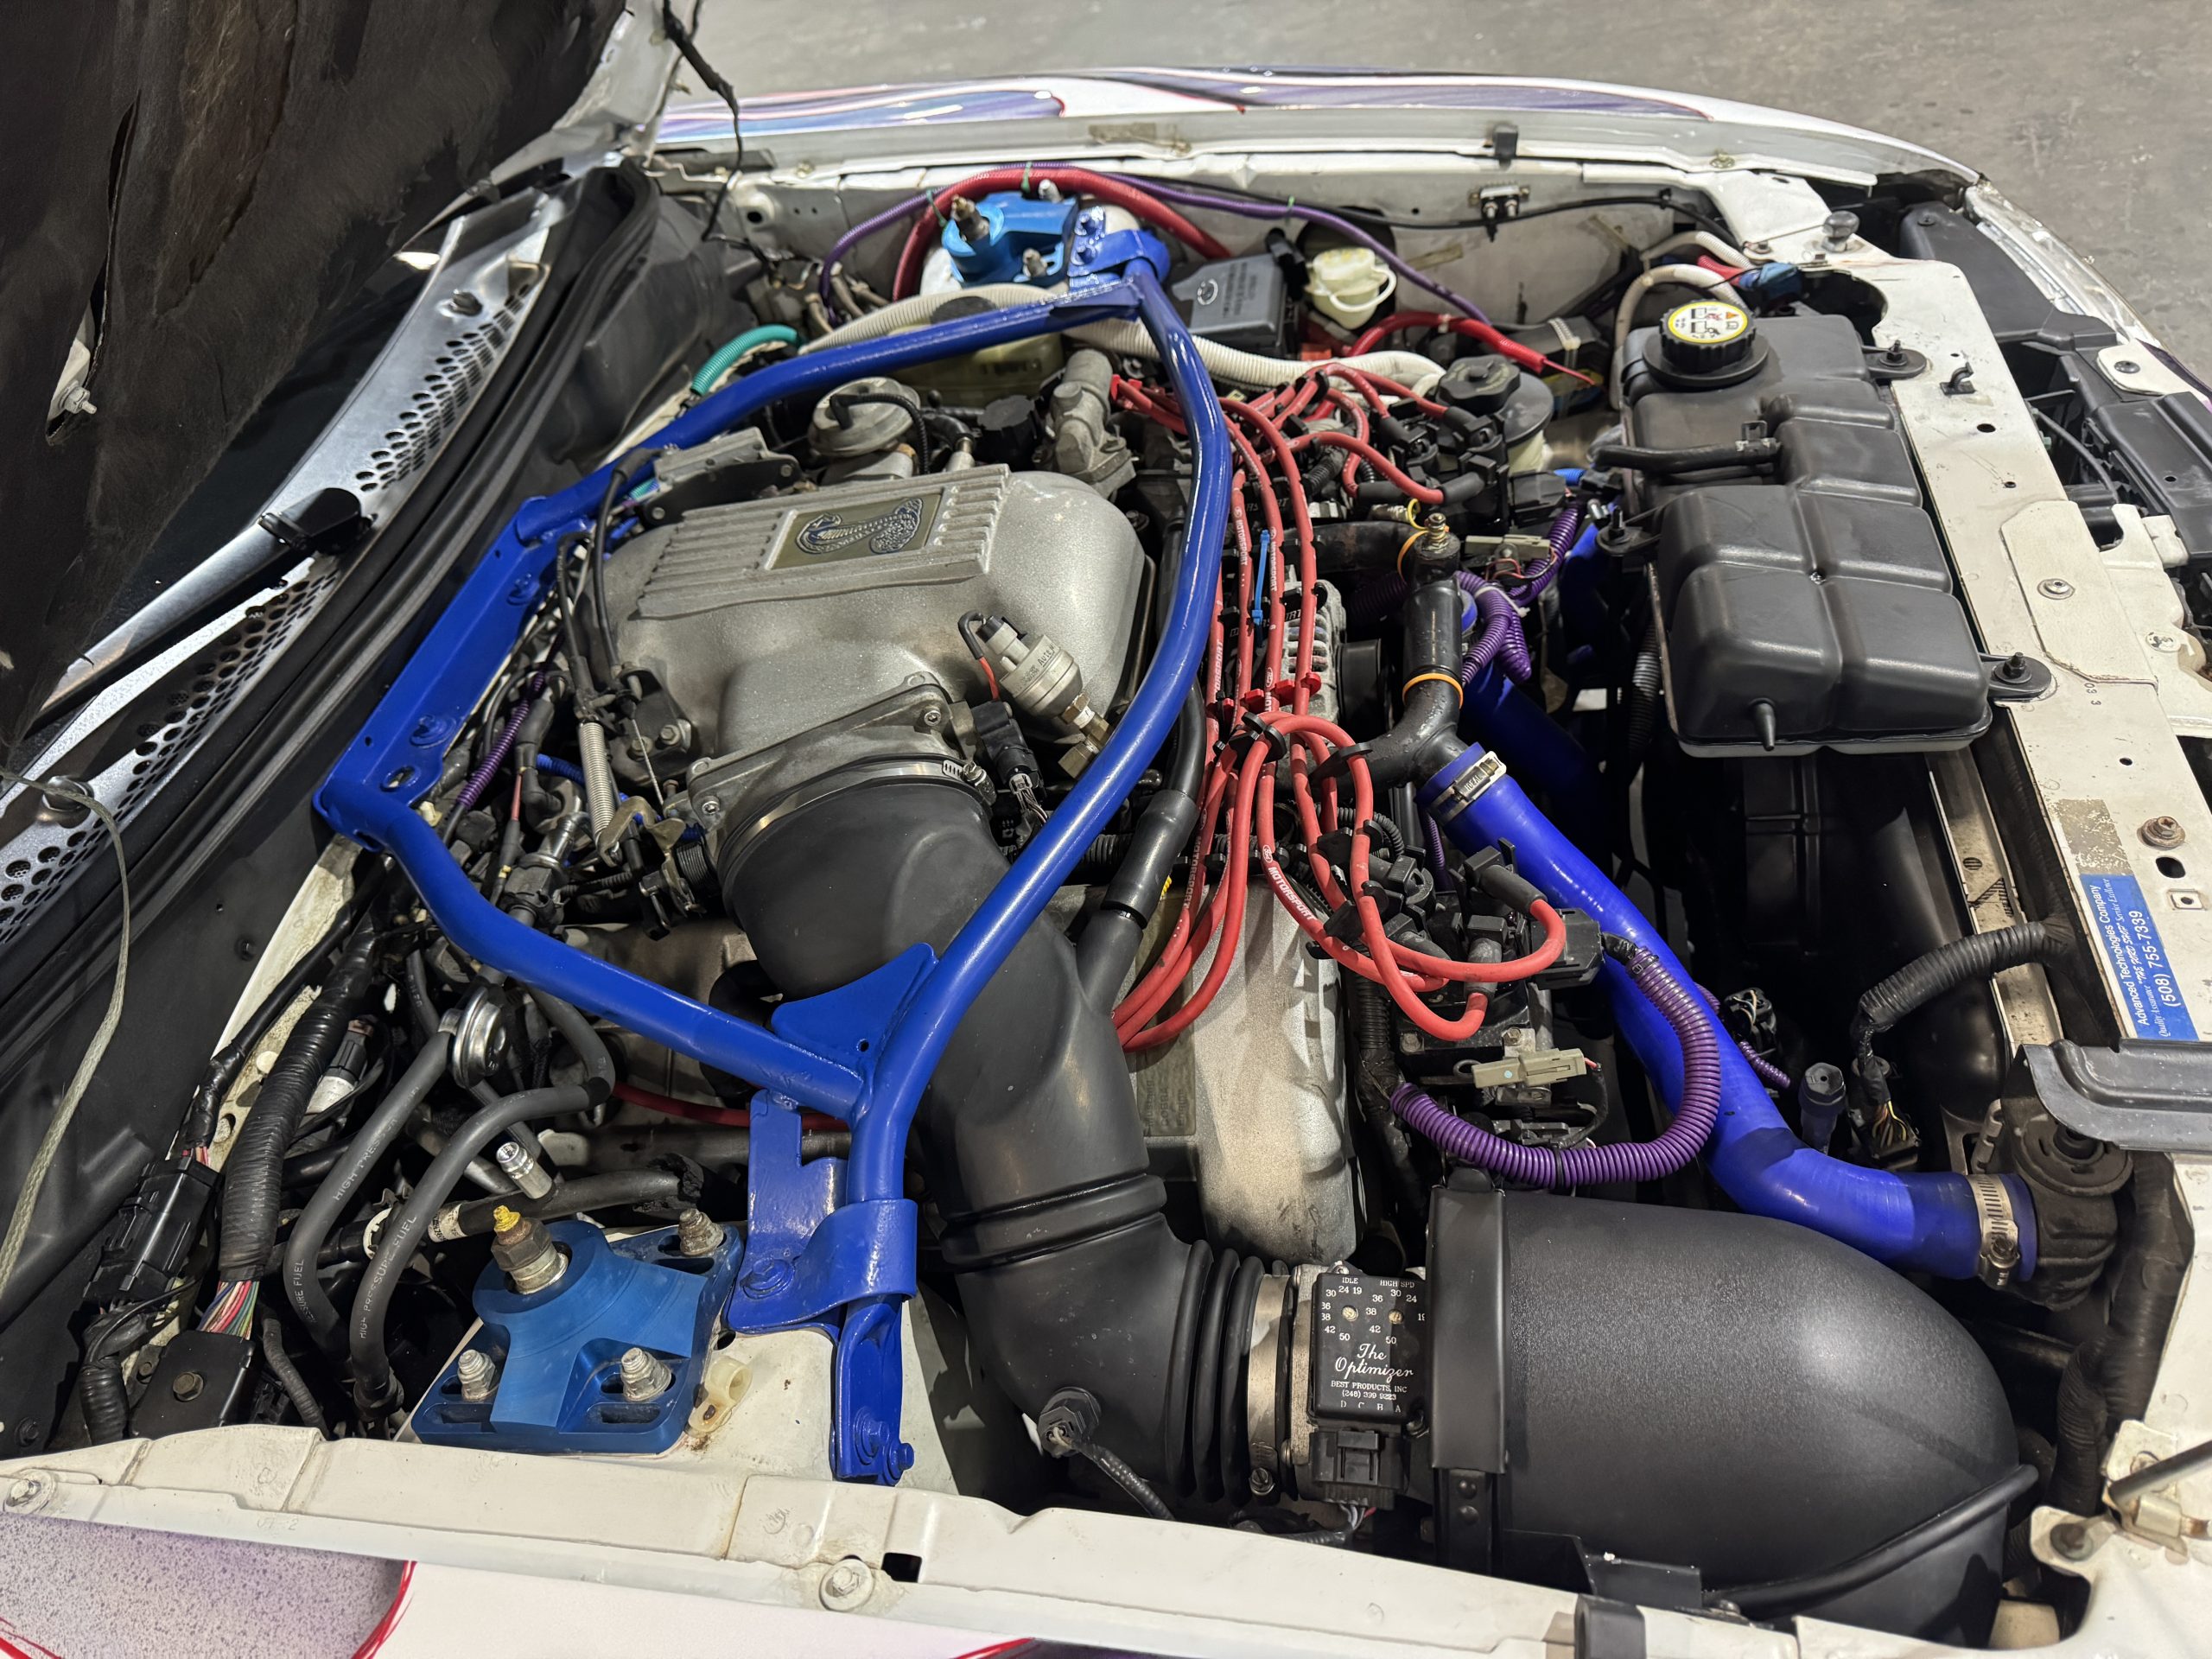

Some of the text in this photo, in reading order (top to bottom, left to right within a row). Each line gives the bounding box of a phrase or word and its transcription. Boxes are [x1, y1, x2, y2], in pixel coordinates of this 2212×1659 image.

[1268, 866, 1319, 921] MOTORSPORT
[2102, 878, 2118, 902] Excellence
[2112, 903, 2126, 922] Service
[2089, 885, 2150, 1026] Advanced Technologies Company
[2126, 945, 2142, 964] FORD
[2128, 910, 2182, 1007] (508) 755-7339
[2144, 985, 2160, 1013] Assurance
[2154, 1014, 2171, 1037] Quality
[333, 1172, 358, 1201] HIGH
[293, 1259, 304, 1287] FUEL
[1390, 1288, 1402, 1297] 30
[1406, 1294, 1417, 1303] 24
[1321, 1313, 1331, 1321] 38
[1338, 1332, 1351, 1341] 50
[1369, 1325, 1381, 1333] 42
[1385, 1336, 1397, 1344] 50
[1357, 1343, 1387, 1360] The
[1334, 1356, 1414, 1383] Optimizer
[1342, 1389, 1361, 1399] (248)
[1352, 1382, 1392, 1393] PRODUCTS,
